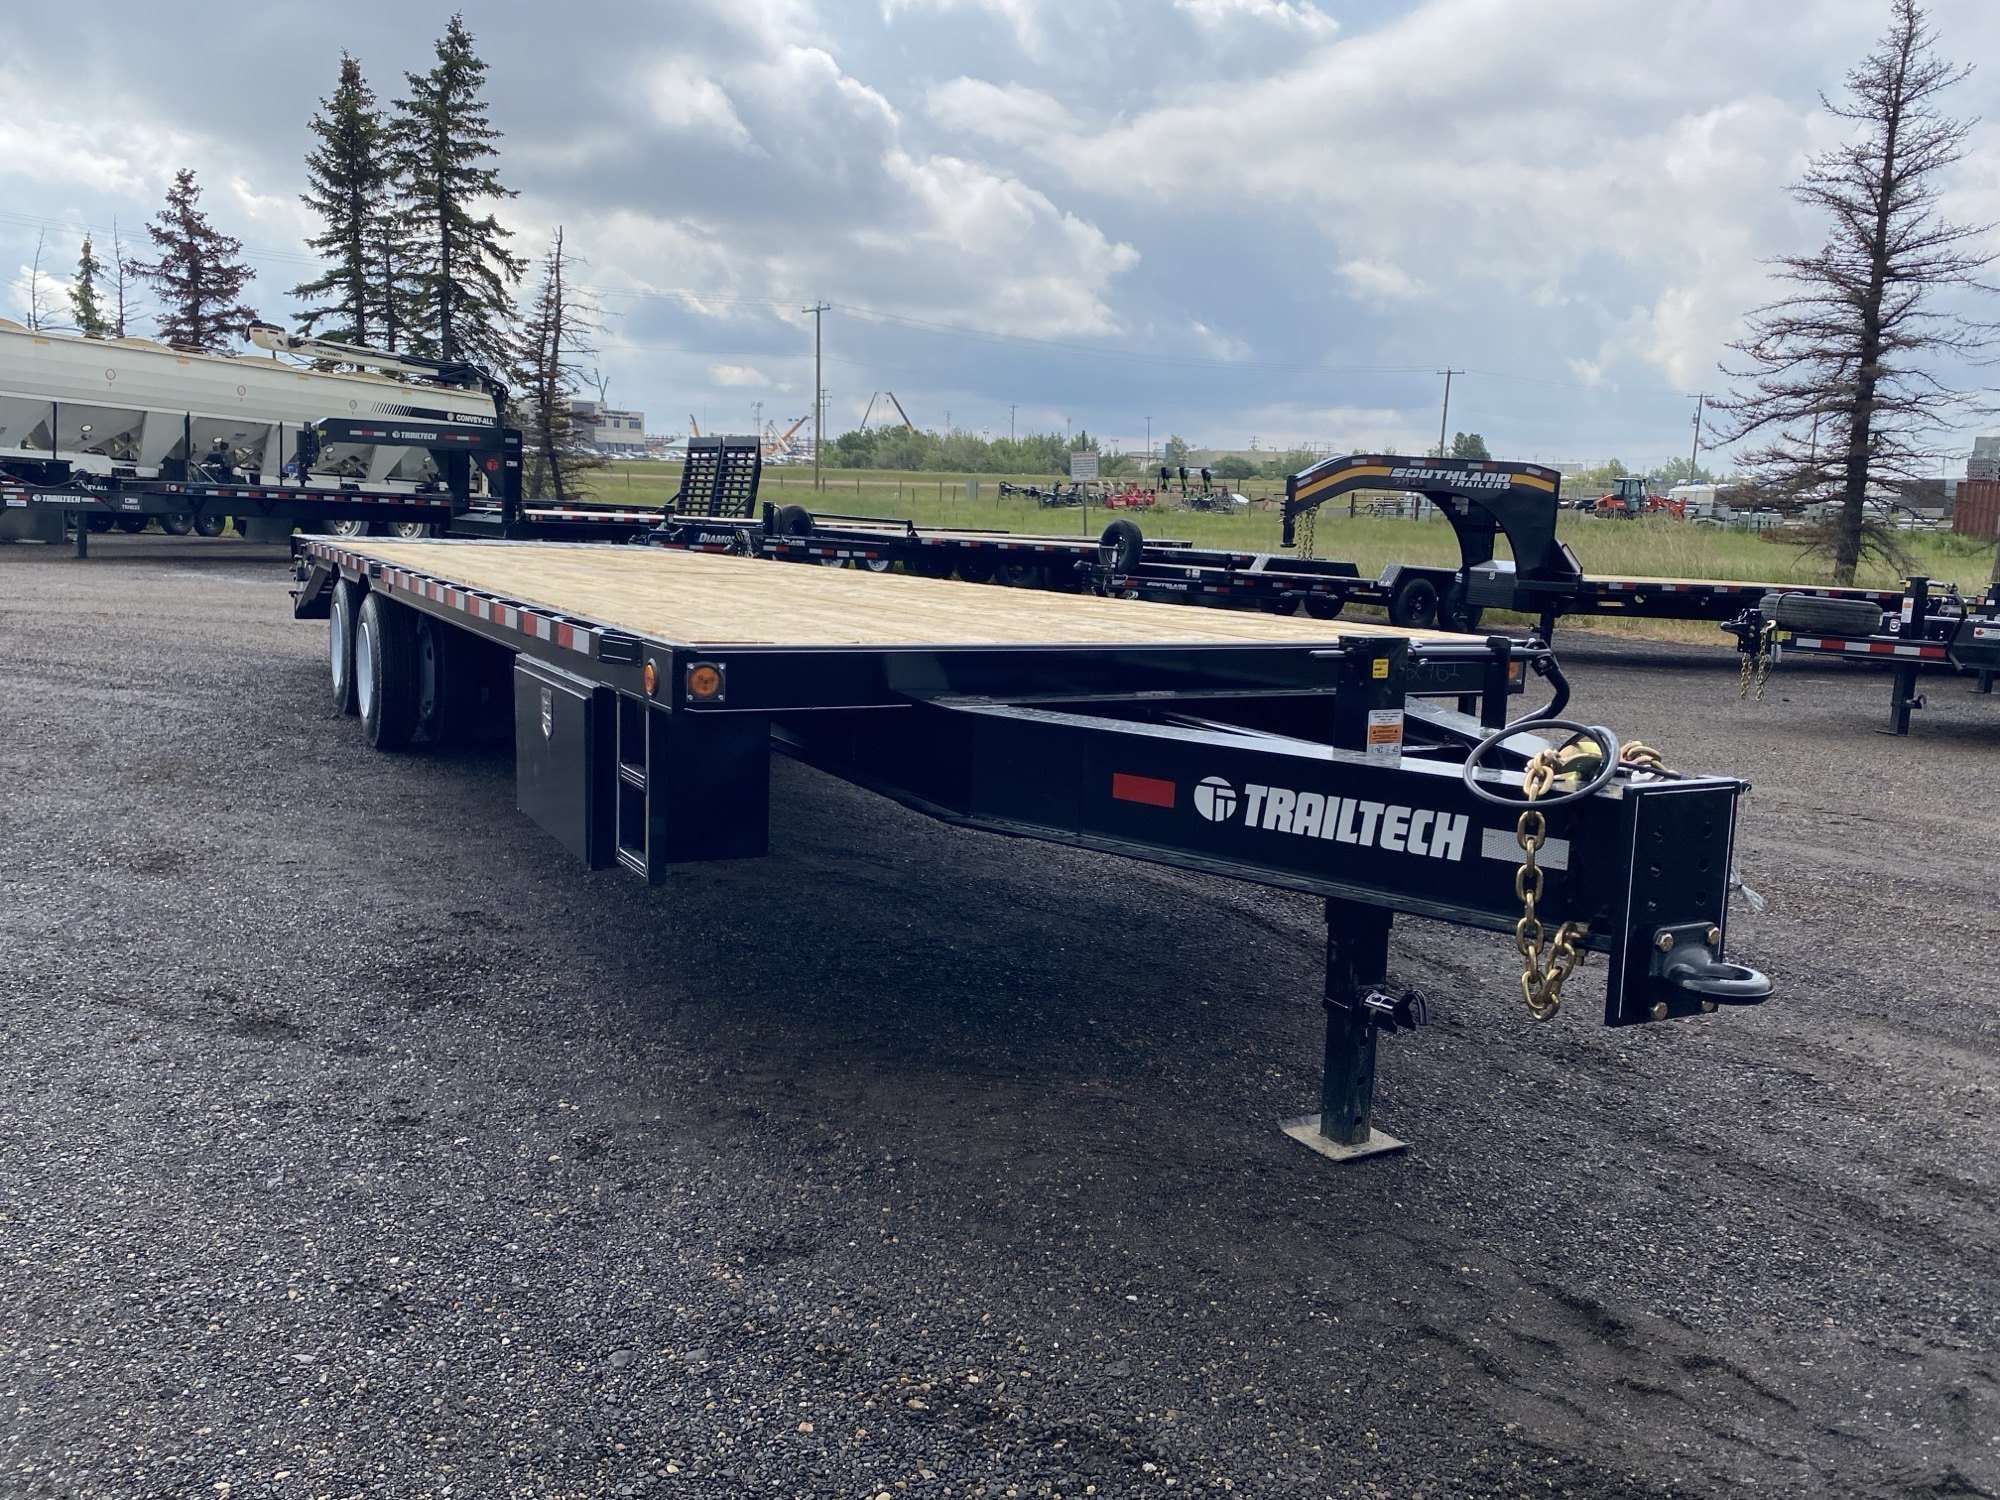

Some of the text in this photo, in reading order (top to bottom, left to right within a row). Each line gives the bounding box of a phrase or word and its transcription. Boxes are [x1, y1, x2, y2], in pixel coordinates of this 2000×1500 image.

[456, 415, 494, 425] CONVEY-ALL
[1391, 468, 1512, 482] SOUTHLAND
[1450, 480, 1511, 489] TRAILERS
[699, 532, 736, 544] DIAMO
[1244, 783, 1469, 861] TRAILTECH
